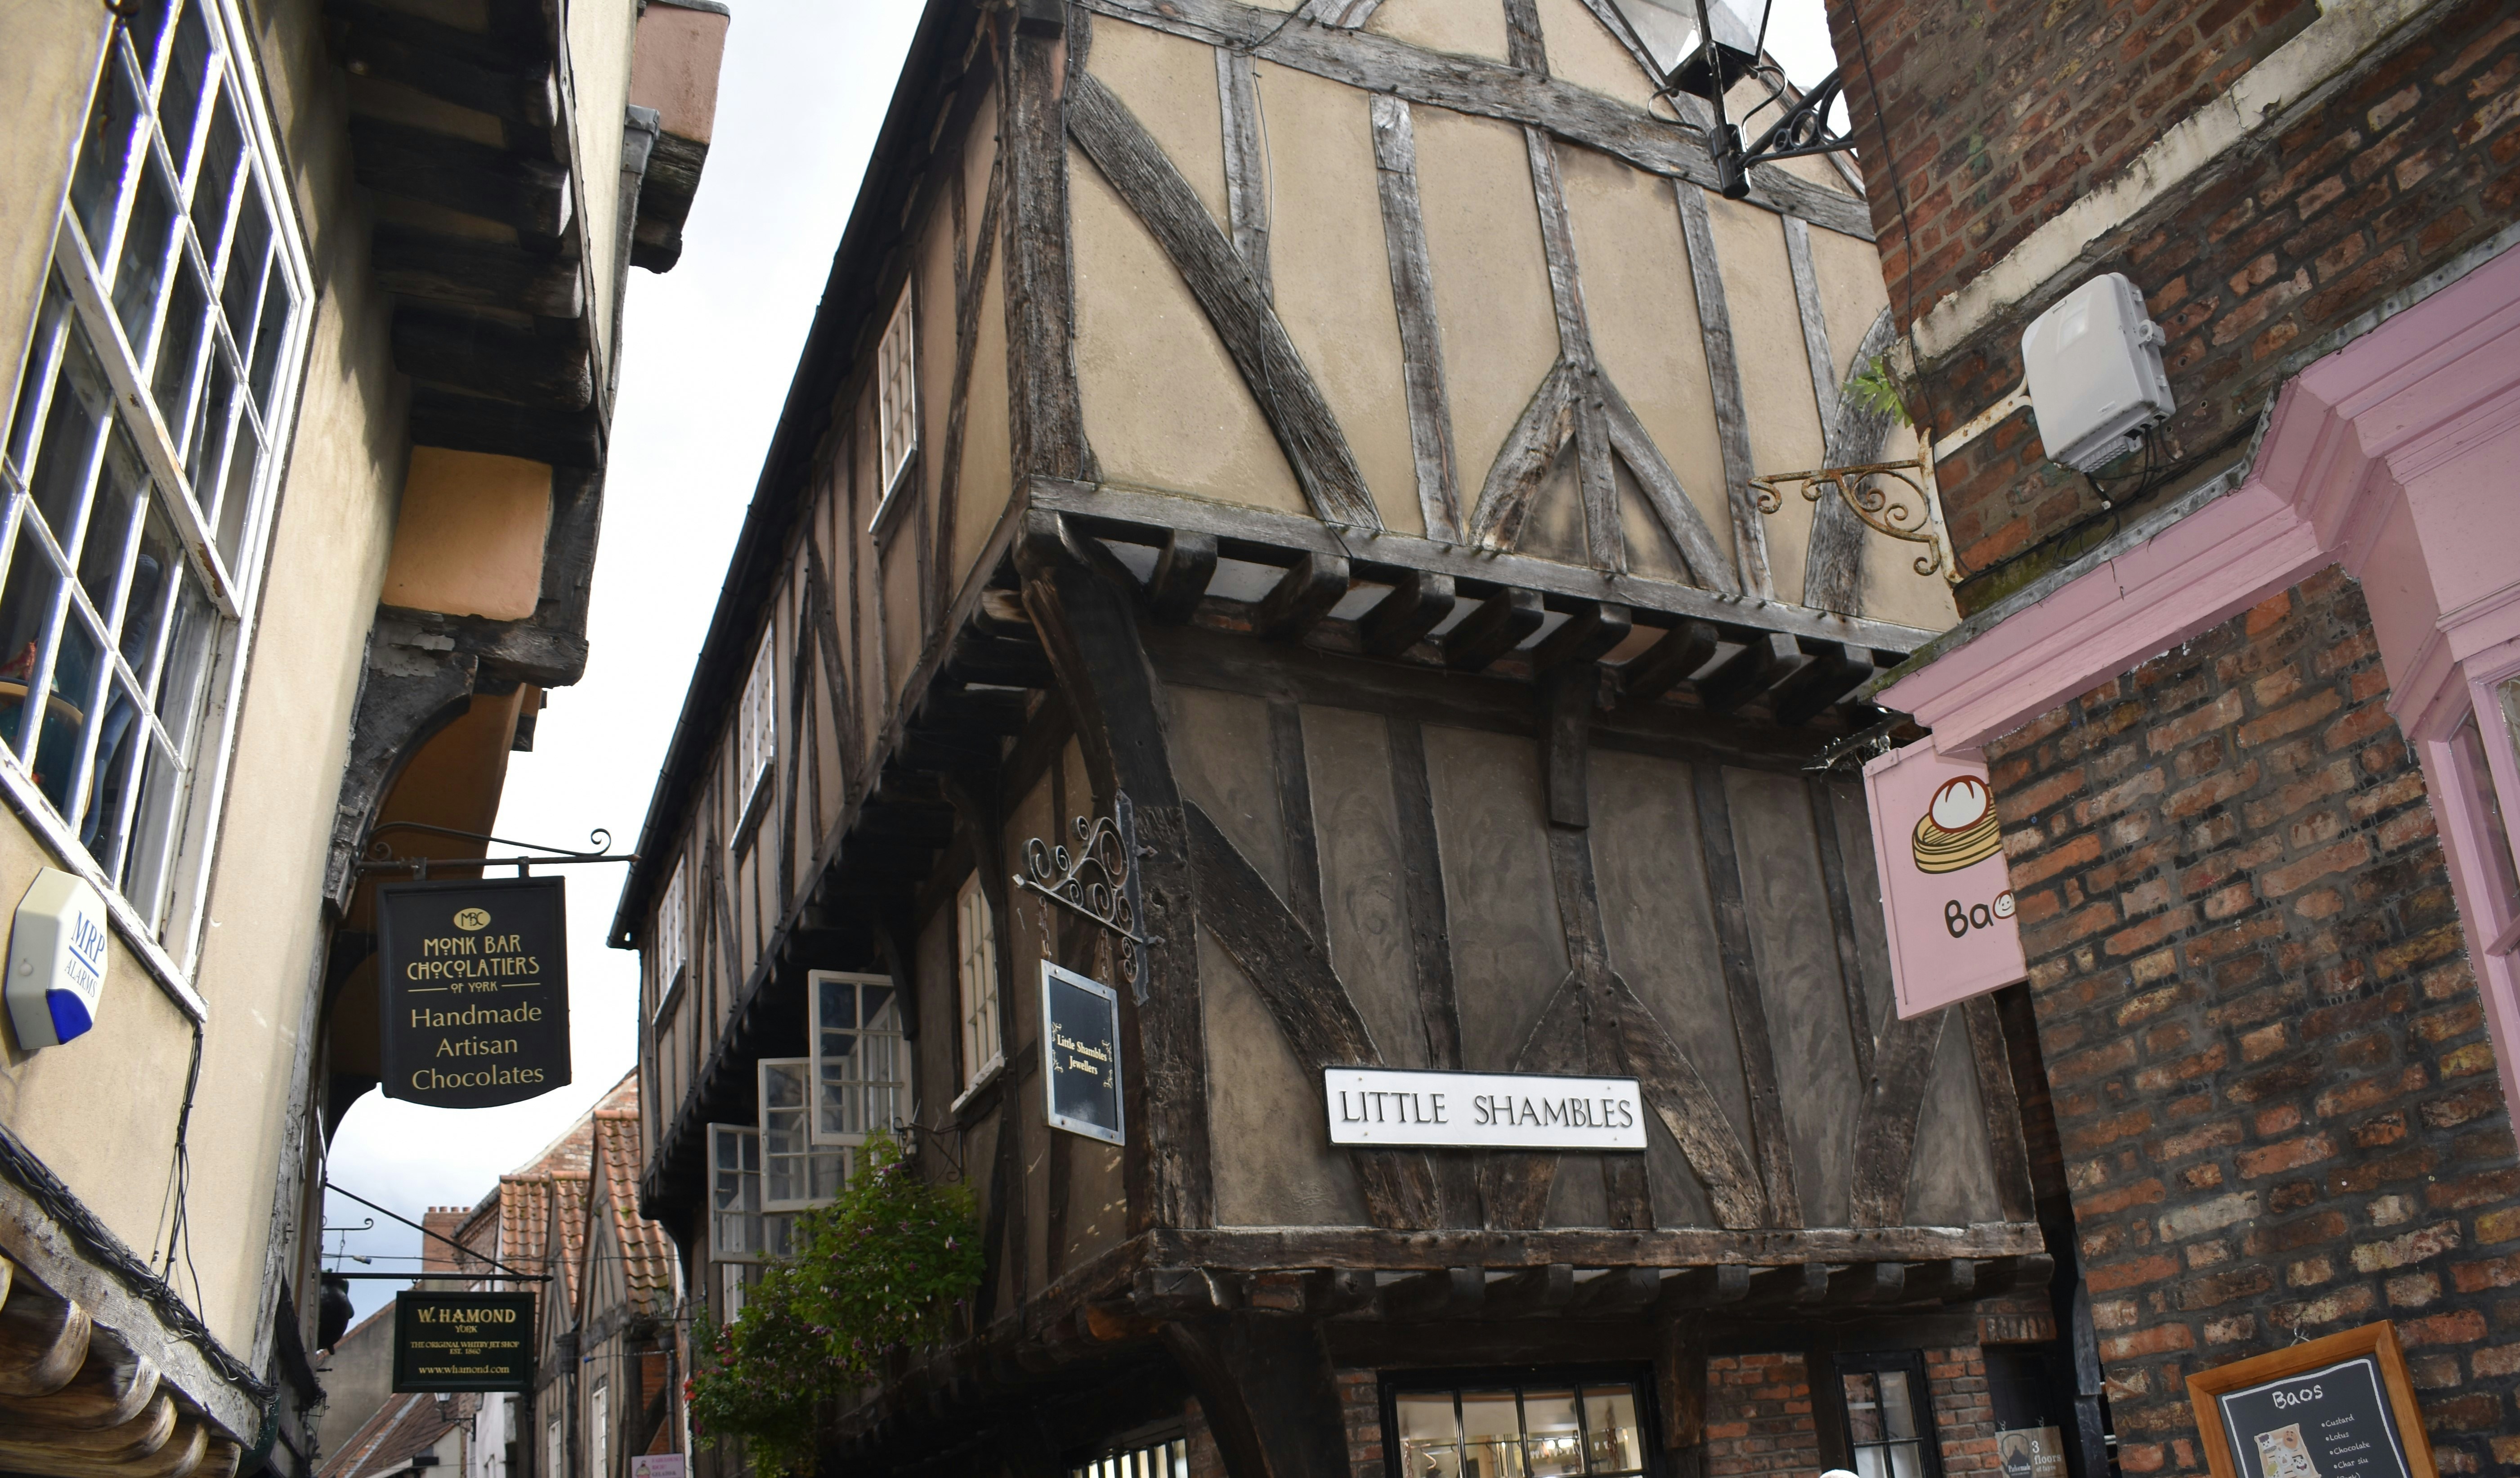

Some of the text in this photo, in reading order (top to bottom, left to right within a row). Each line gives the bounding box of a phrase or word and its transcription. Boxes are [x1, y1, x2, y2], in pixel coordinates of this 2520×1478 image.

[461, 911, 484, 926] MBC
[71, 910, 105, 964] MRP
[424, 934, 521, 956] MONK BAR
[407, 957, 540, 980] CHOCOLATIERS
[64, 958, 98, 998] ALARMS
[451, 981, 498, 993] OF YORK
[412, 1002, 542, 1027] Handmade
[436, 1036, 518, 1057] Artisan
[1057, 1034, 1107, 1062] Little Shambles
[1069, 1055, 1098, 1075] Jewellers
[412, 1064, 544, 1090] Chocolates
[1339, 1091, 1633, 1127] LITTLE SHAMBLES
[417, 1306, 516, 1323] W. HAMOND
[455, 1325, 478, 1333] YORK
[418, 1365, 510, 1374] www.whamond.com
[2272, 1384, 2323, 1409] Baos
[2326, 1414, 2355, 1427] Custard
[2329, 1432, 2350, 1441] Lotus
[2032, 1440, 2040, 1454] 3
[2333, 1441, 2371, 1455] Chocolate
[2034, 1454, 2062, 1465] floors
[2338, 1460, 2355, 1469] Char
